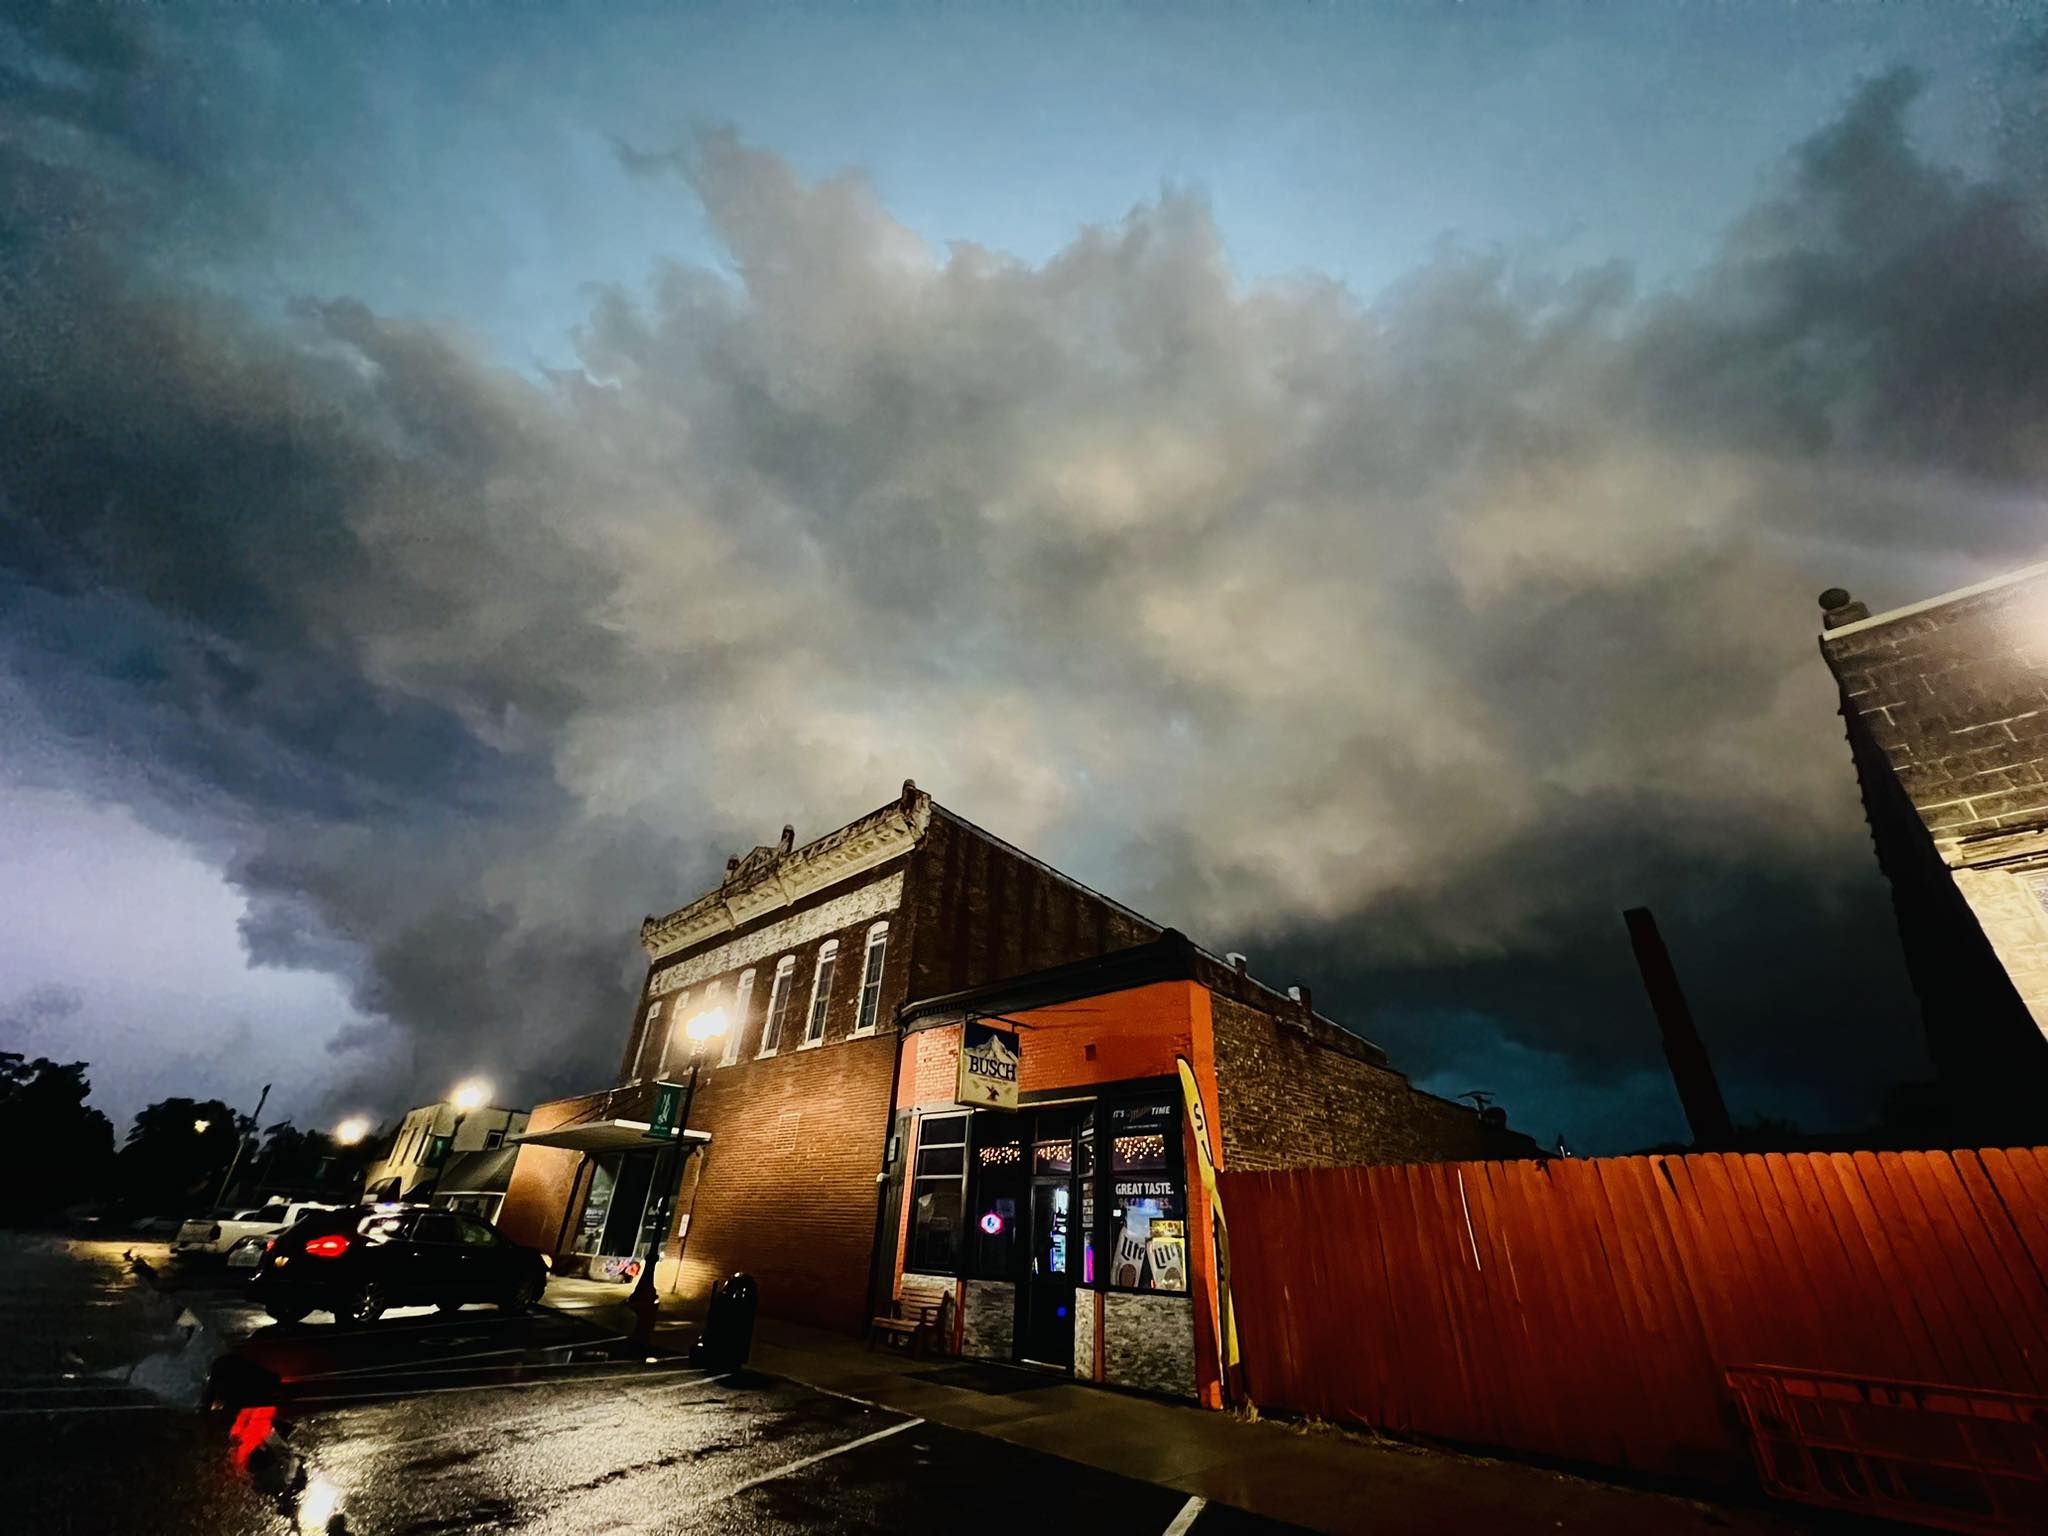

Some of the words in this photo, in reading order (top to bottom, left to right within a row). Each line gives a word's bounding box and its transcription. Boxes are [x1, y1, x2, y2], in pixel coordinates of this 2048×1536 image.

[969, 1055, 1016, 1081] BUSCH
[1112, 1109, 1125, 1119] IT'S
[1151, 1105, 1171, 1116] TIME
[1115, 1183, 1143, 1195] GREAT
[1144, 1182, 1174, 1195] TASTE.
[1121, 1236, 1145, 1261] Lite
[1154, 1243, 1175, 1269] Lite
